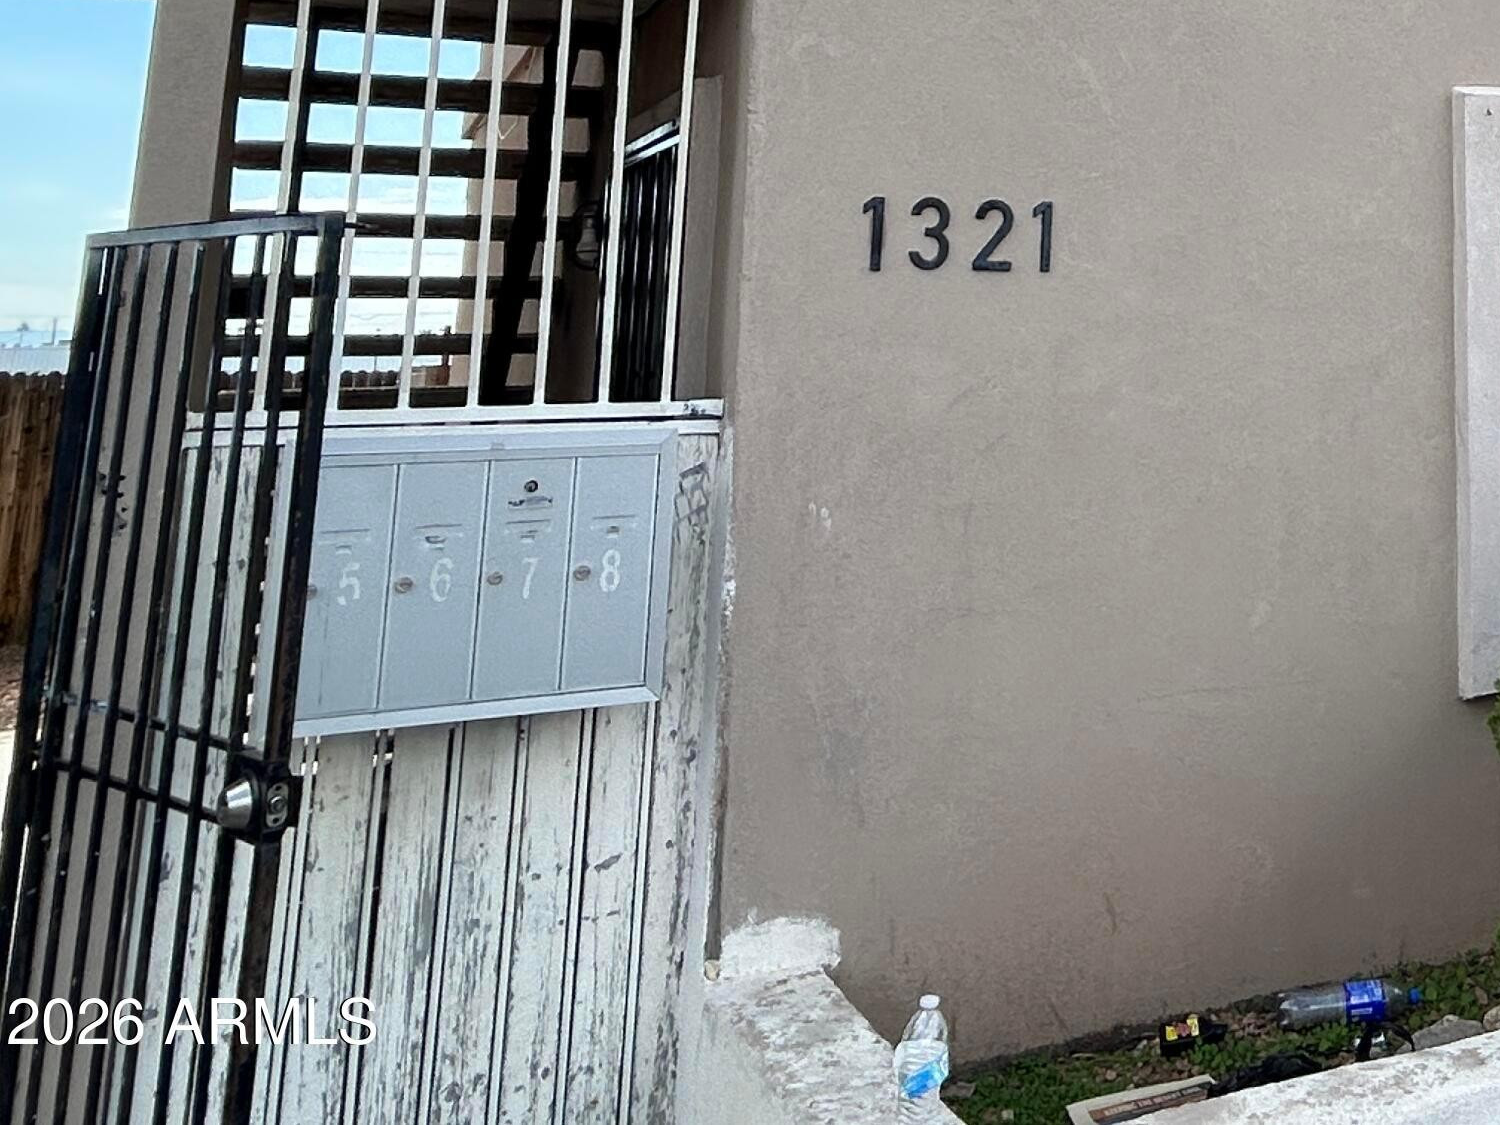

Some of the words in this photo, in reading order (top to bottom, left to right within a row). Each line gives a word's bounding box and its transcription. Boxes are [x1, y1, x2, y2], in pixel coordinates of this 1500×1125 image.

[862, 196, 1053, 272] 1321
[337, 563, 360, 606] 5
[430, 557, 454, 602] 6
[522, 557, 539, 599] 7
[599, 549, 621, 593] 8
